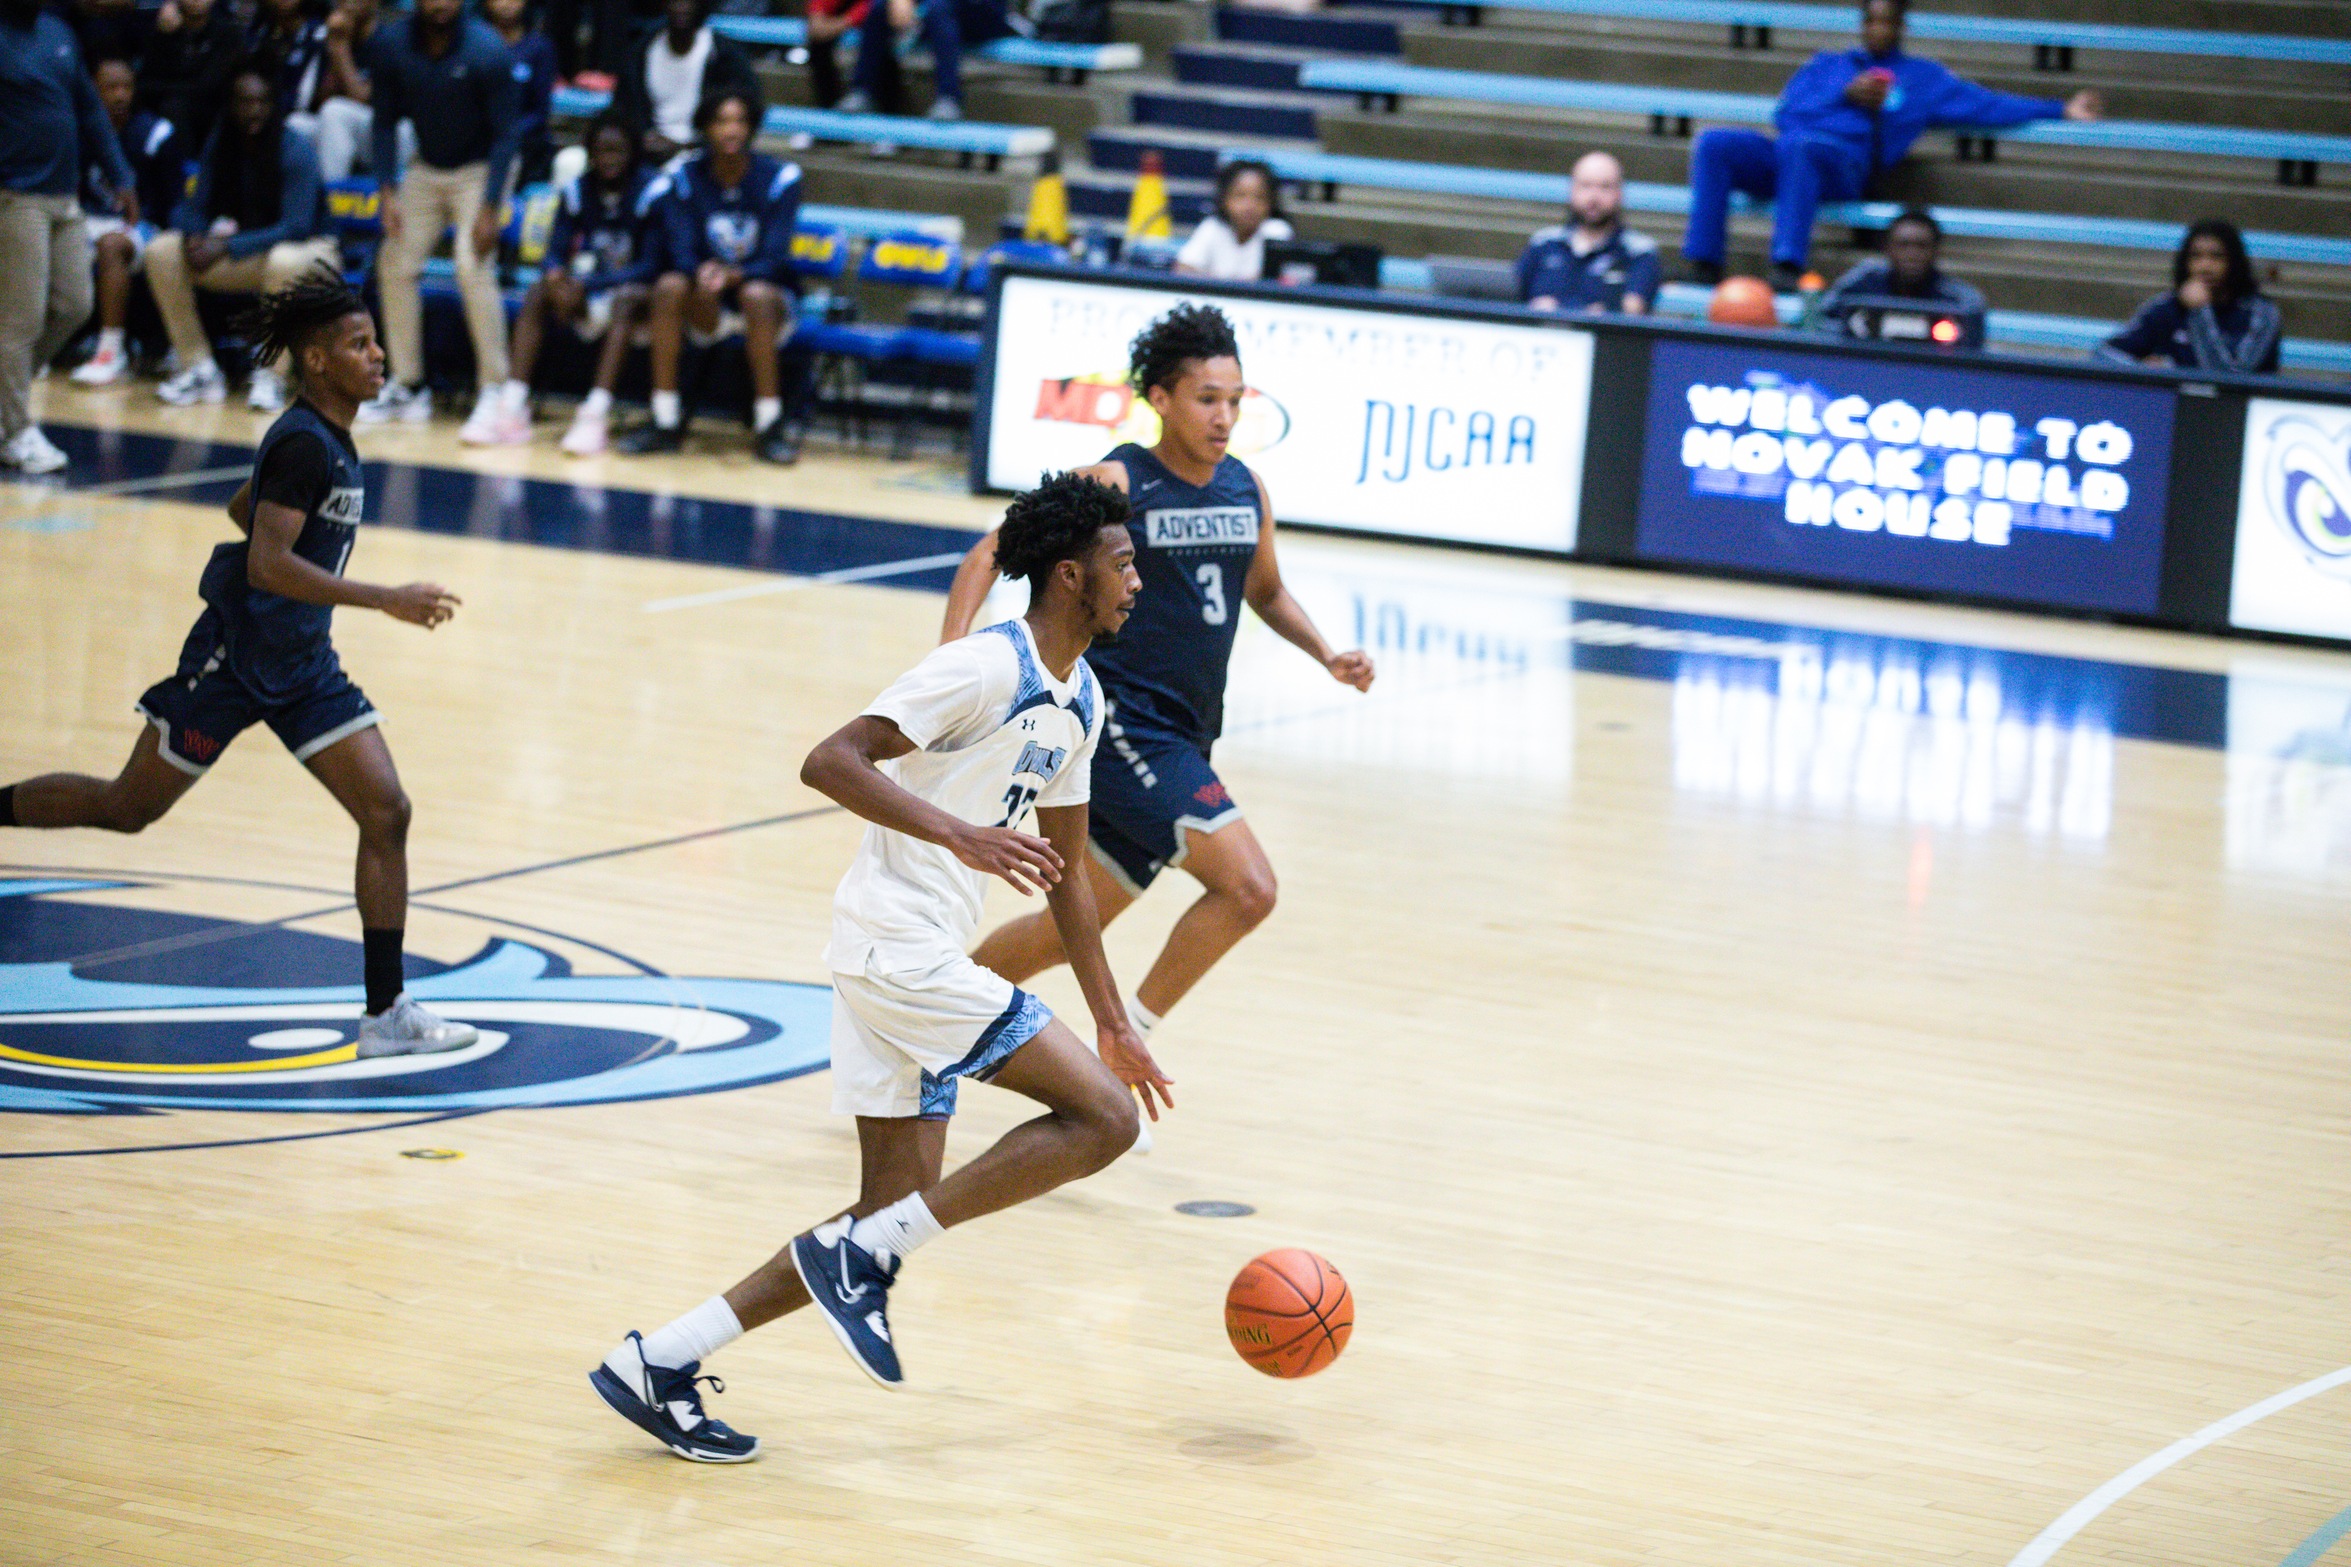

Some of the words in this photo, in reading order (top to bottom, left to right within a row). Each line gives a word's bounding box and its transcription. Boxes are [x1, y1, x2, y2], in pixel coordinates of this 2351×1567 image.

[1240, 318, 1467, 373] MEMBER
[1490, 340, 1560, 382] OF
[1355, 399, 1537, 484] NJCAA
[1687, 384, 2016, 454] WELCOME
[2036, 417, 2132, 465] TO
[1785, 479, 2012, 546] HOUSE
[1943, 453, 2129, 511] FIELD
[1157, 513, 1252, 539] ADVENTIST
[1196, 563, 1227, 625] 3
[1012, 741, 1067, 783] OWLS
